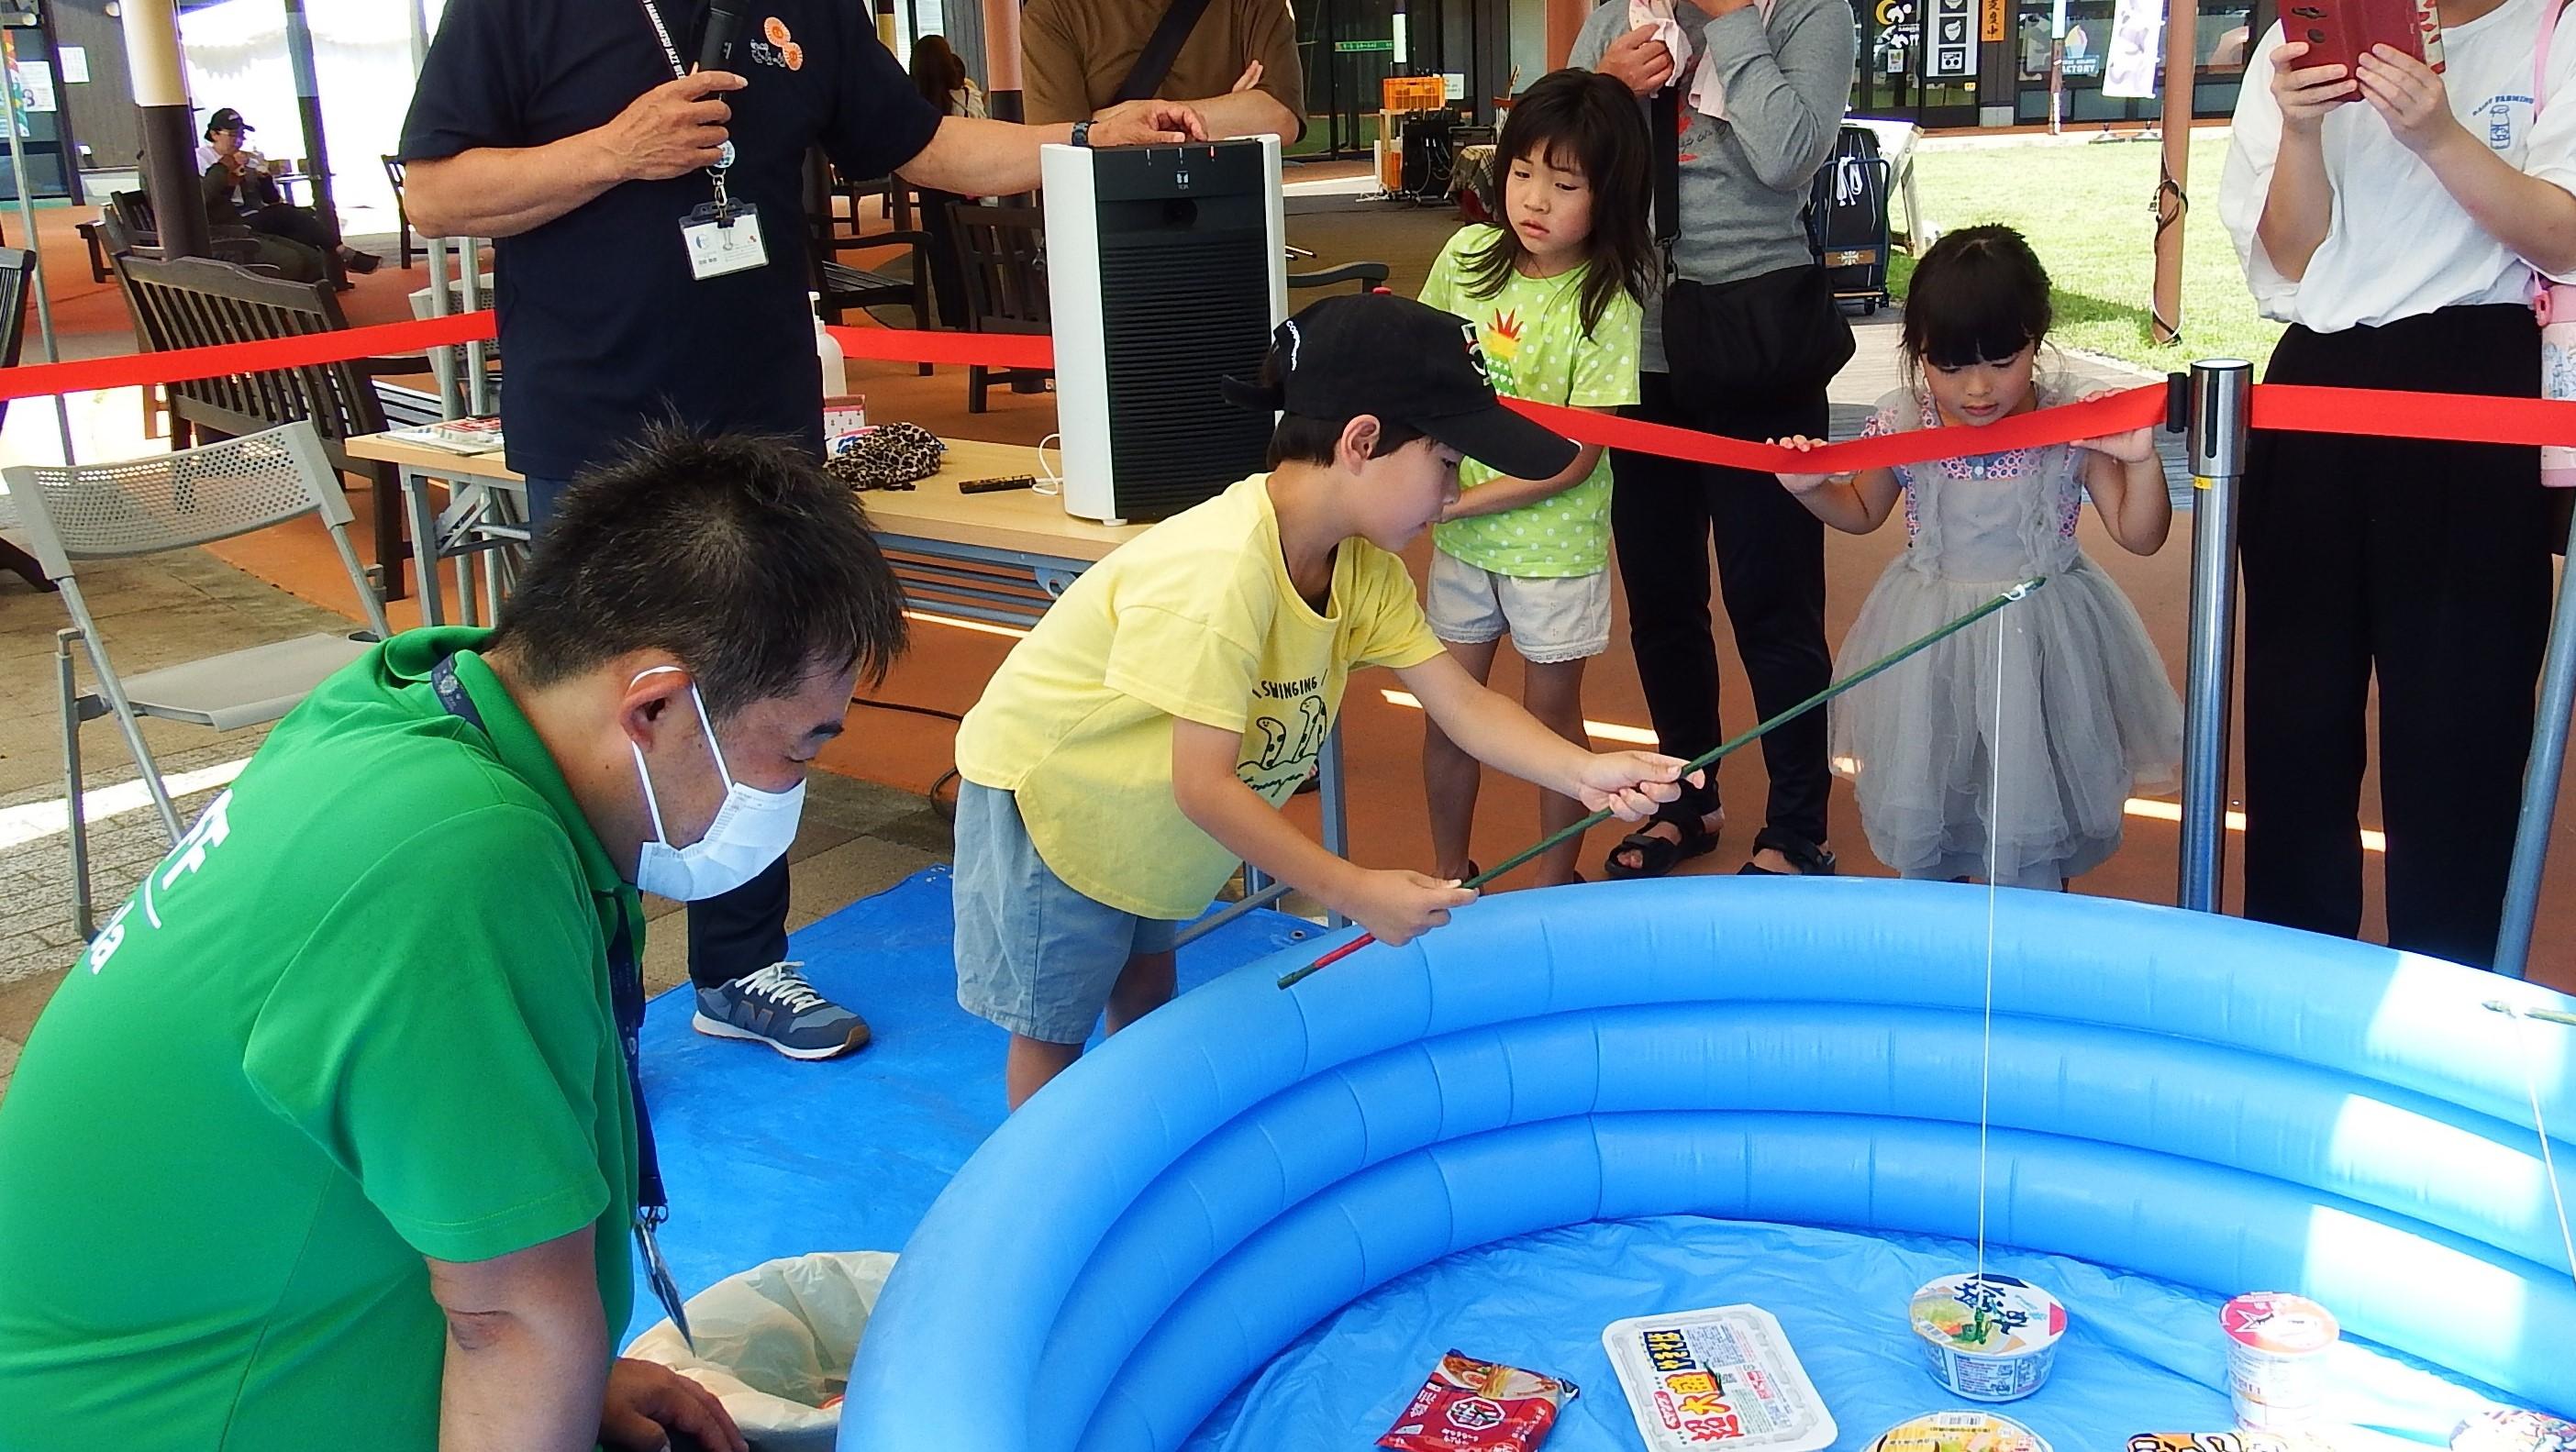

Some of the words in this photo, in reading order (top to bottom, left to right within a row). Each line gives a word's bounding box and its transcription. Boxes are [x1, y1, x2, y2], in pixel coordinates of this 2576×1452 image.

[665, 48, 681, 65] JAZZ
[2061, 64, 2096, 73] ACTORY
[1260, 677, 1317, 699] SWINGING
